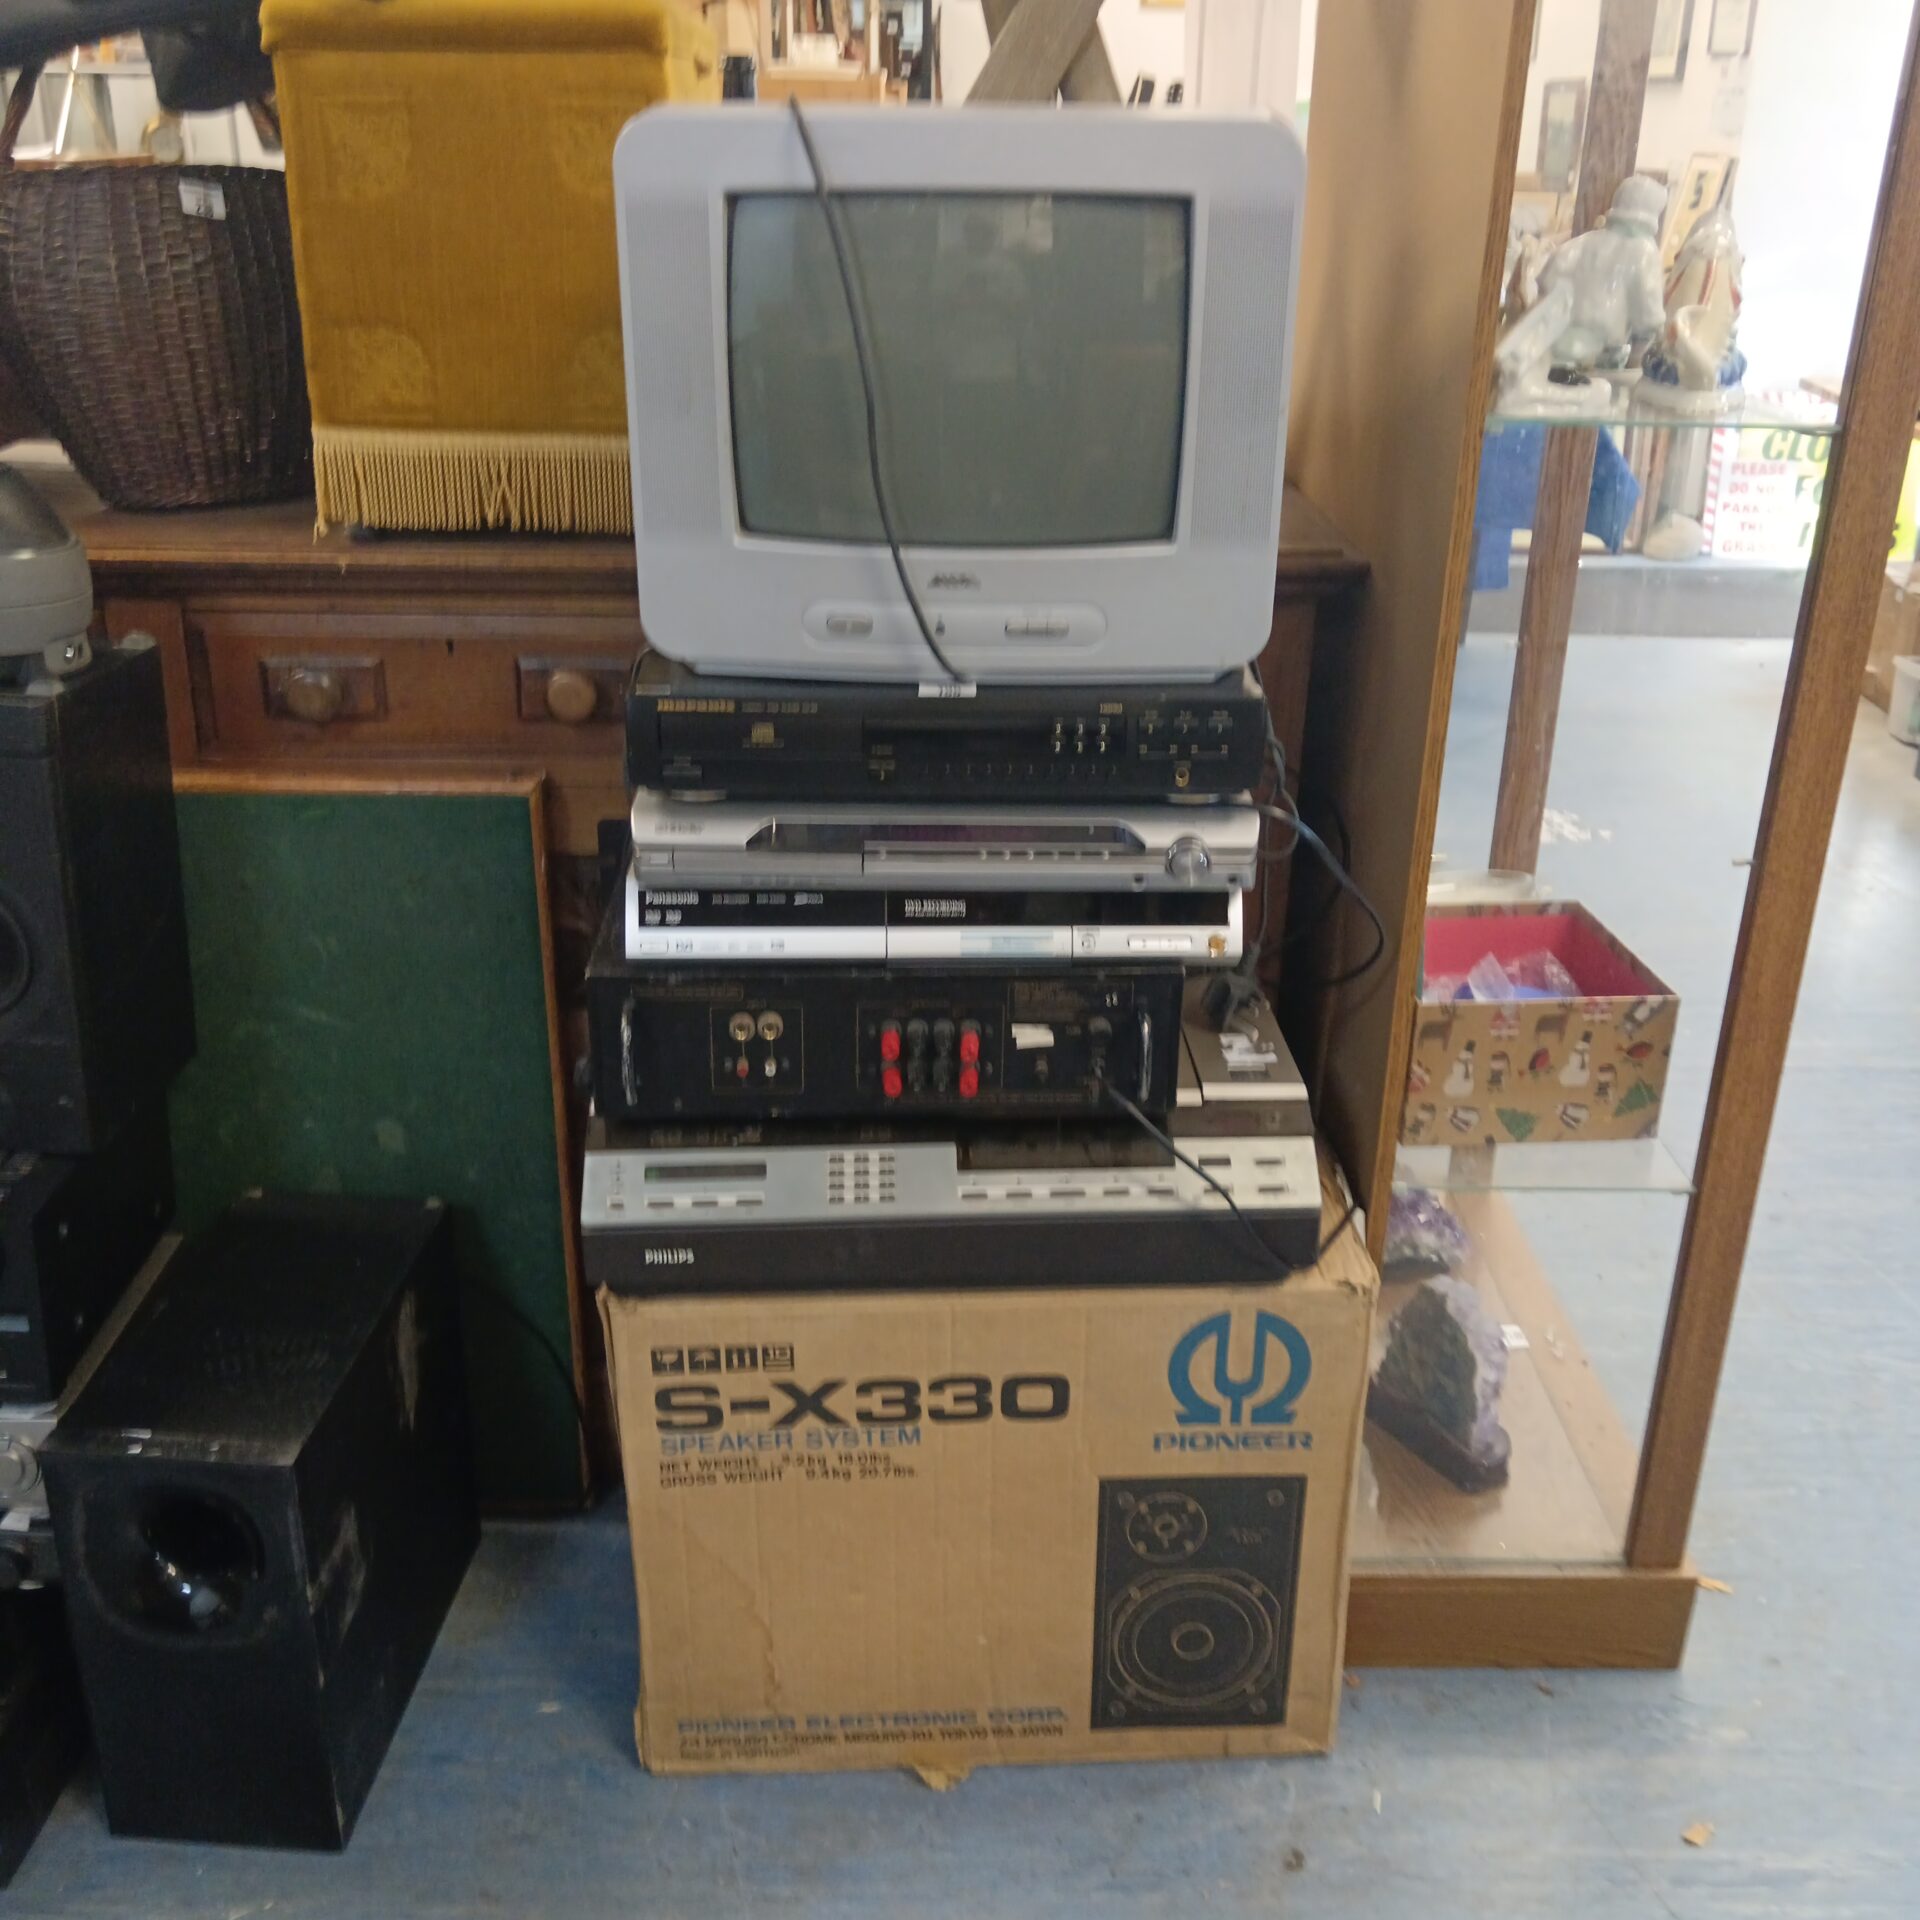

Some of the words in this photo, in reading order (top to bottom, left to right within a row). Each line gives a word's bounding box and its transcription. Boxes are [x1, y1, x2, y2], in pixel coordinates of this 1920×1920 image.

[1731, 462, 1786, 476] PLEASE
[645, 1248, 694, 1264] PHILIPS
[655, 1373, 1070, 1432] S-X330
[660, 1430, 793, 1456] SPEAKER
[806, 1424, 921, 1450] SYSTEM
[1154, 1431, 1313, 1452] PIONEER
[677, 1715, 797, 1734] PIONEER
